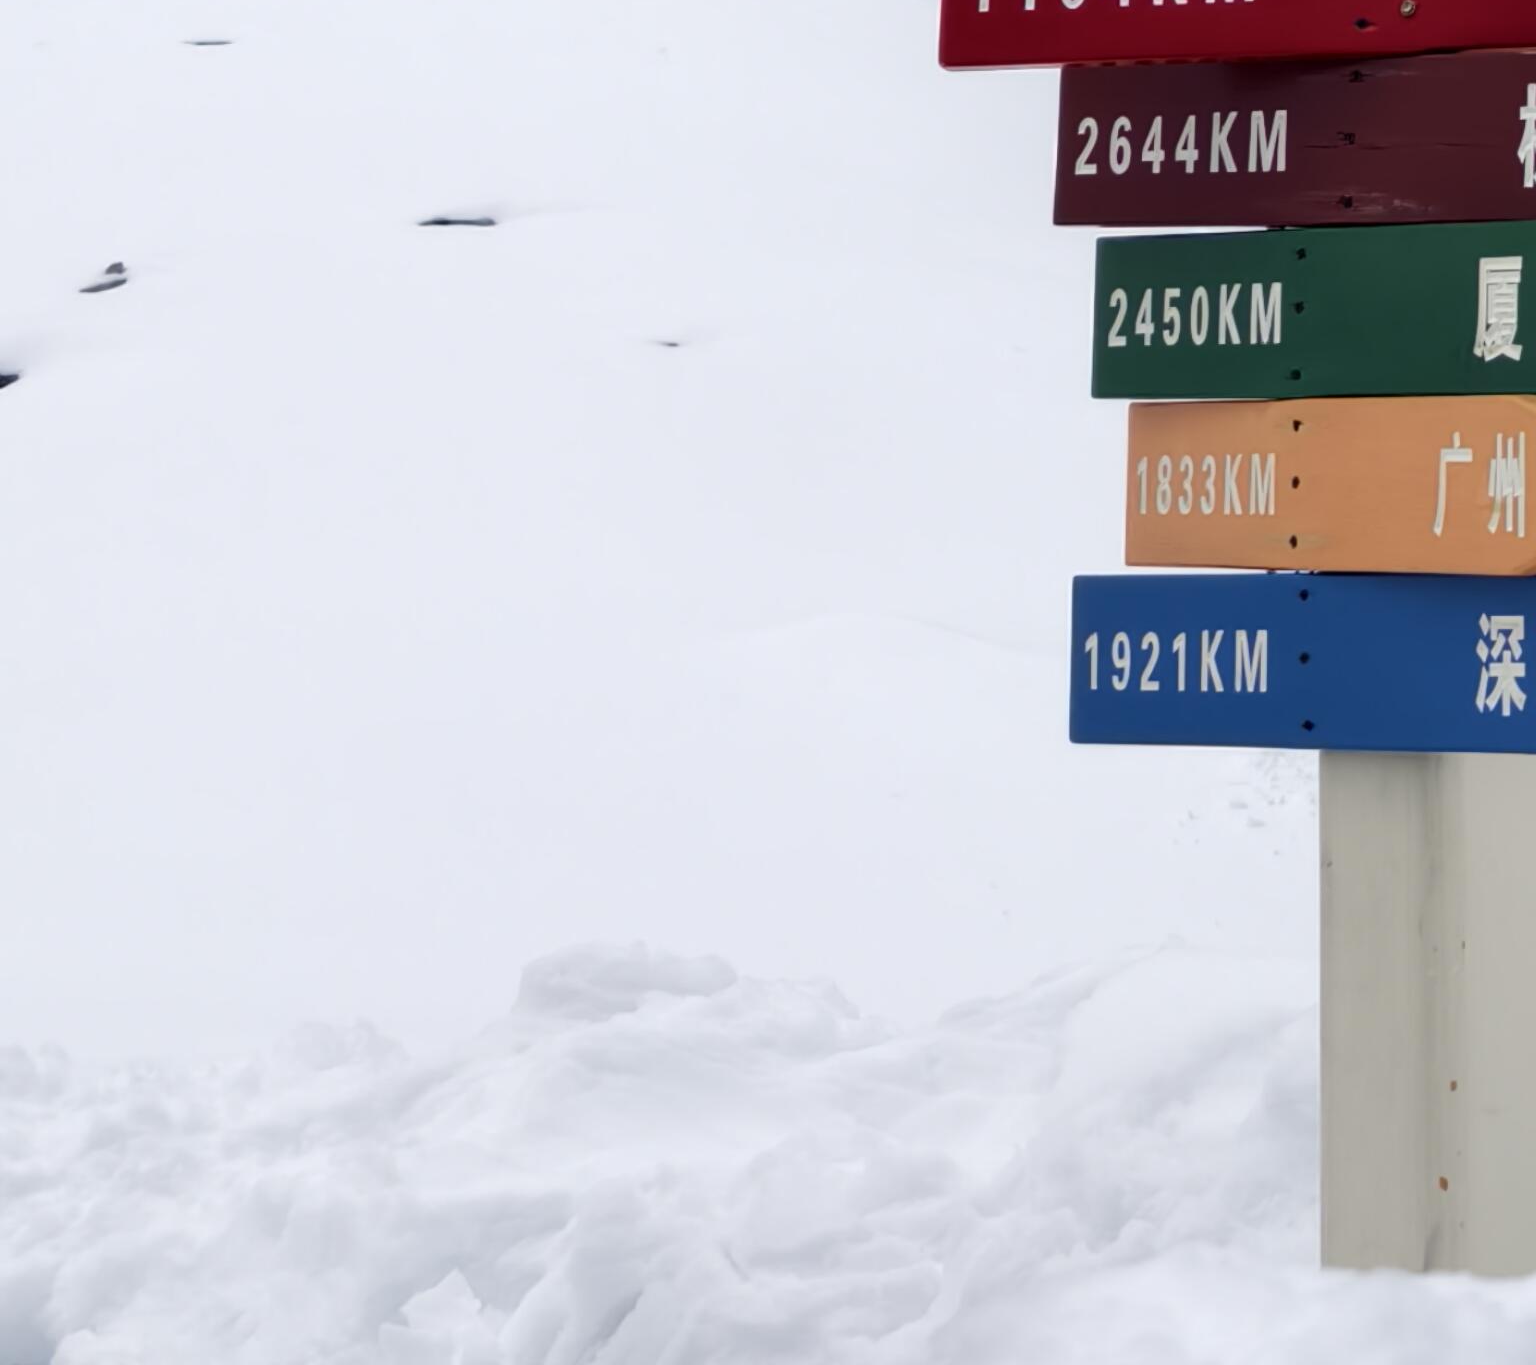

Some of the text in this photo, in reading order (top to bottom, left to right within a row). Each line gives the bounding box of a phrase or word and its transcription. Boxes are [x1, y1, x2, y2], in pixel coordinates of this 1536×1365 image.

[1075, 110, 1287, 175] 2644KM
[1108, 282, 1281, 347] 2450KM
[1137, 432, 1525, 537] 1833KM 广州
[1085, 630, 1267, 692] 1921KM
